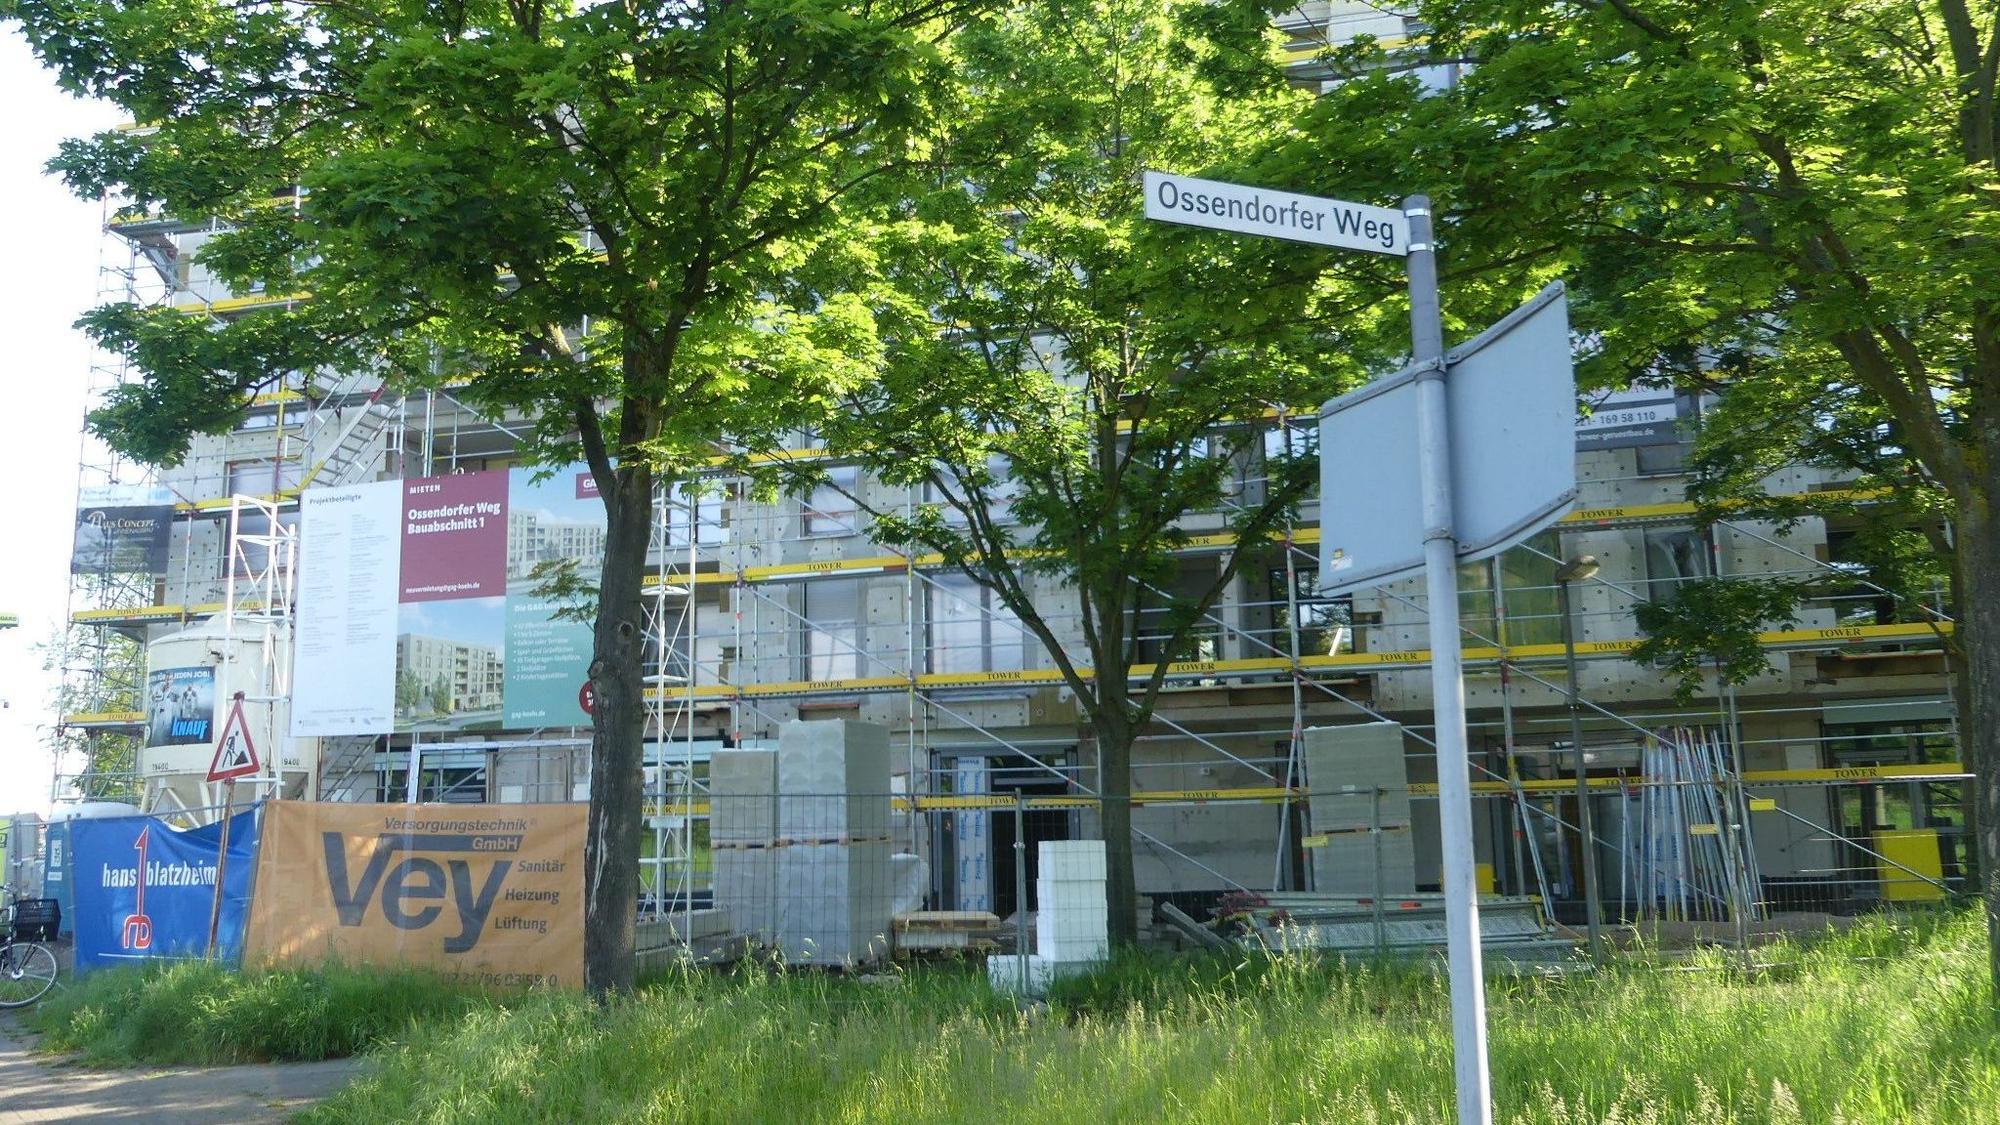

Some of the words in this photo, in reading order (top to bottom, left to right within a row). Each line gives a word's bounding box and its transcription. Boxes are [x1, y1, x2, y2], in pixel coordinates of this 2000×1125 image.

[1158, 181, 1325, 231] Ossendorfer
[1334, 207, 1395, 248] Weg
[1600, 415, 1618, 424] 169
[1622, 413, 1634, 422] 58
[1637, 411, 1656, 421] 110
[583, 478, 597, 488] GA
[410, 484, 441, 494] MIETEN
[310, 494, 361, 505] Projektbeteiligte
[408, 504, 475, 520] Ossendorfer
[476, 502, 501, 515] Weg
[1580, 509, 1624, 518] TOWER
[407, 519, 478, 535] Bauabschnitt
[478, 516, 485, 528] 1
[807, 562, 843, 570] TOWER
[1819, 628, 1861, 638] TOWER
[1593, 642, 1632, 651] TOWER
[1379, 652, 1417, 661] TOWER
[1175, 663, 1214, 672] TOWER
[193, 670, 210, 678] JOB!
[987, 671, 1021, 680] TOWER
[808, 681, 843, 689] TOWER
[172, 716, 208, 739] KNAUF
[1835, 767, 1878, 778] TOWER
[1184, 791, 1218, 799] TOWER
[384, 817, 528, 834] Versorgungstechnik
[472, 837, 519, 851] GmbH
[518, 860, 567, 874] Sanitär
[102, 863, 137, 888] hans
[145, 859, 218, 887] blatzheim
[323, 831, 513, 954] Vey
[505, 888, 560, 905] Heizung
[495, 916, 548, 934] Lüftung
